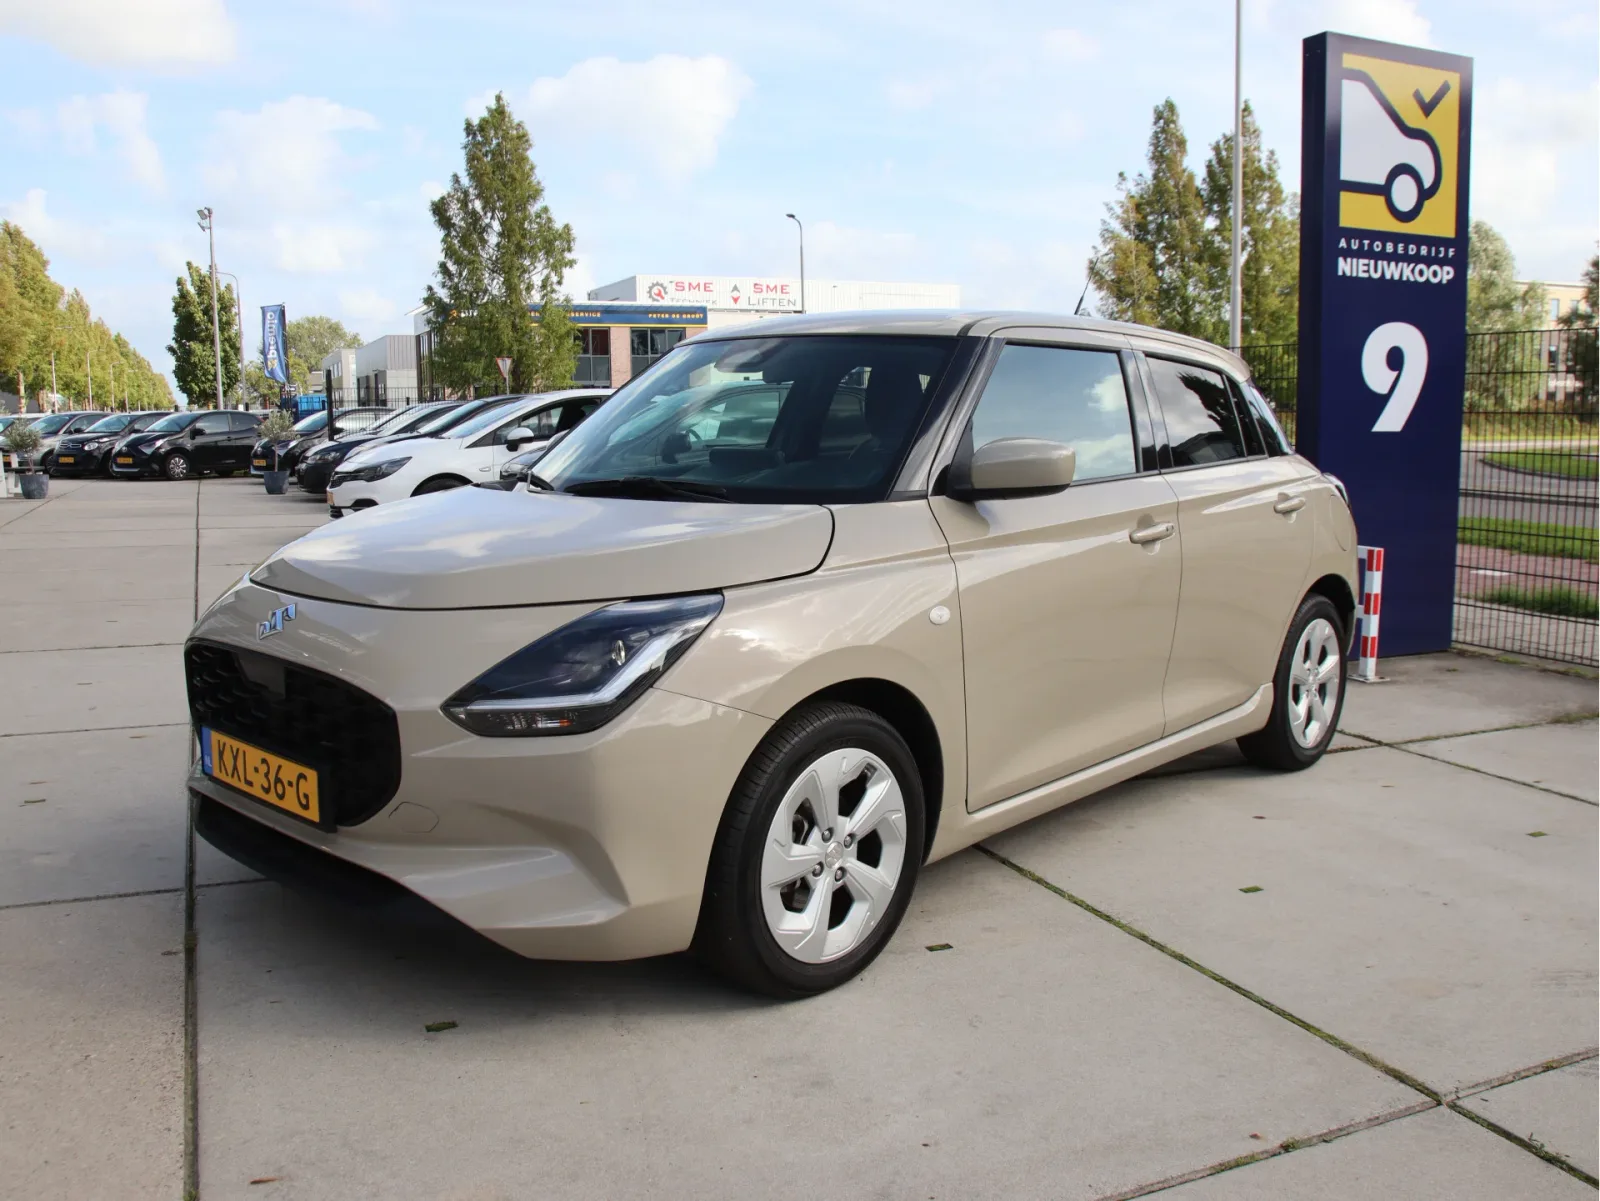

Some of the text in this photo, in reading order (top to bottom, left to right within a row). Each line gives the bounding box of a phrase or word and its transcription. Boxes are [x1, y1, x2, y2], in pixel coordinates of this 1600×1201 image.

[1338, 237, 1456, 258] AUTOBEDRIJF
[1337, 257, 1455, 285] NIEUWKOOP
[674, 281, 714, 292] SME
[753, 282, 790, 295] SME
[748, 296, 797, 307] LIFTEN
[1361, 321, 1429, 432] 9
[217, 739, 310, 811] KXL-36-G
